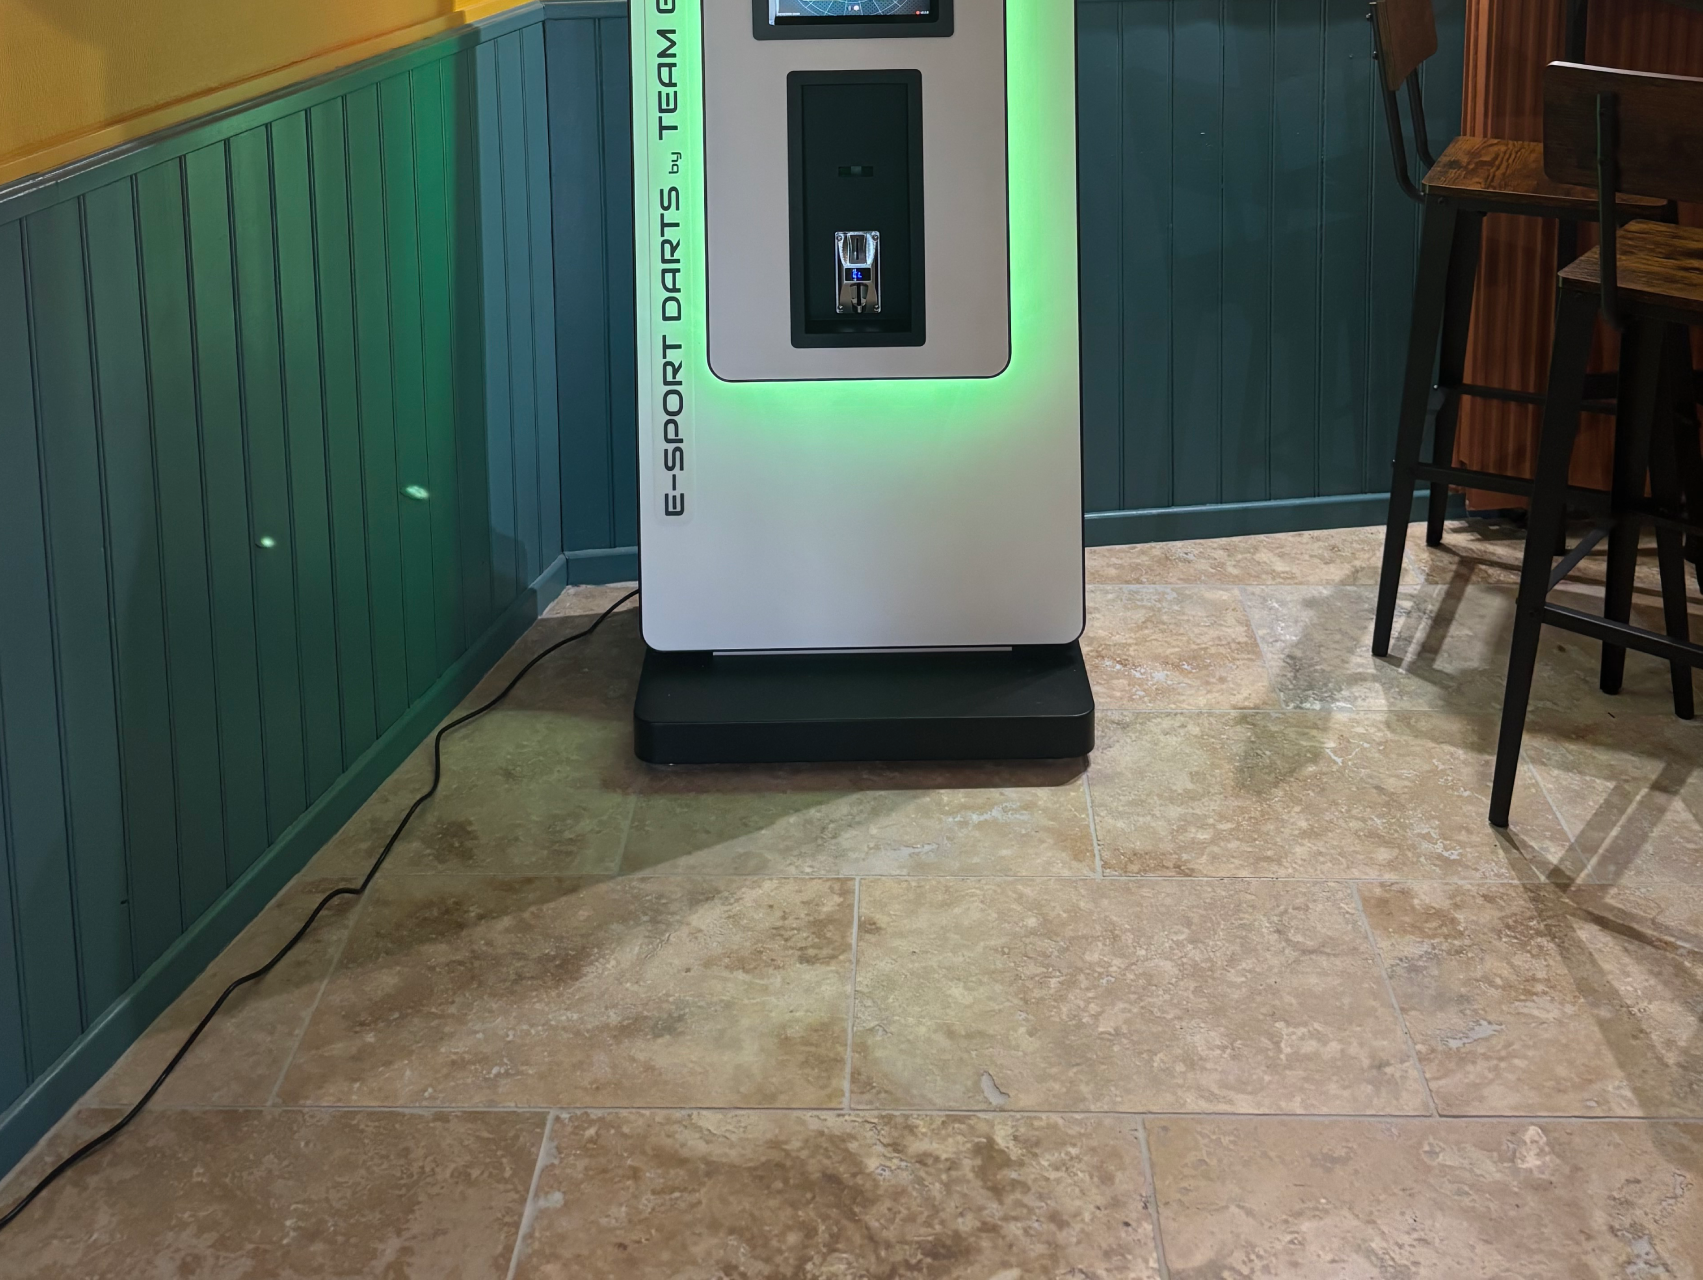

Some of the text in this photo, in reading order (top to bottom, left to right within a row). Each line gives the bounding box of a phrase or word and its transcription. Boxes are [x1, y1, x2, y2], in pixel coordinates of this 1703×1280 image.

[656, 29, 679, 141] TEAM
[668, 151, 682, 175] by
[660, 186, 682, 322] DARTS
[662, 334, 685, 517] E-SPORT
